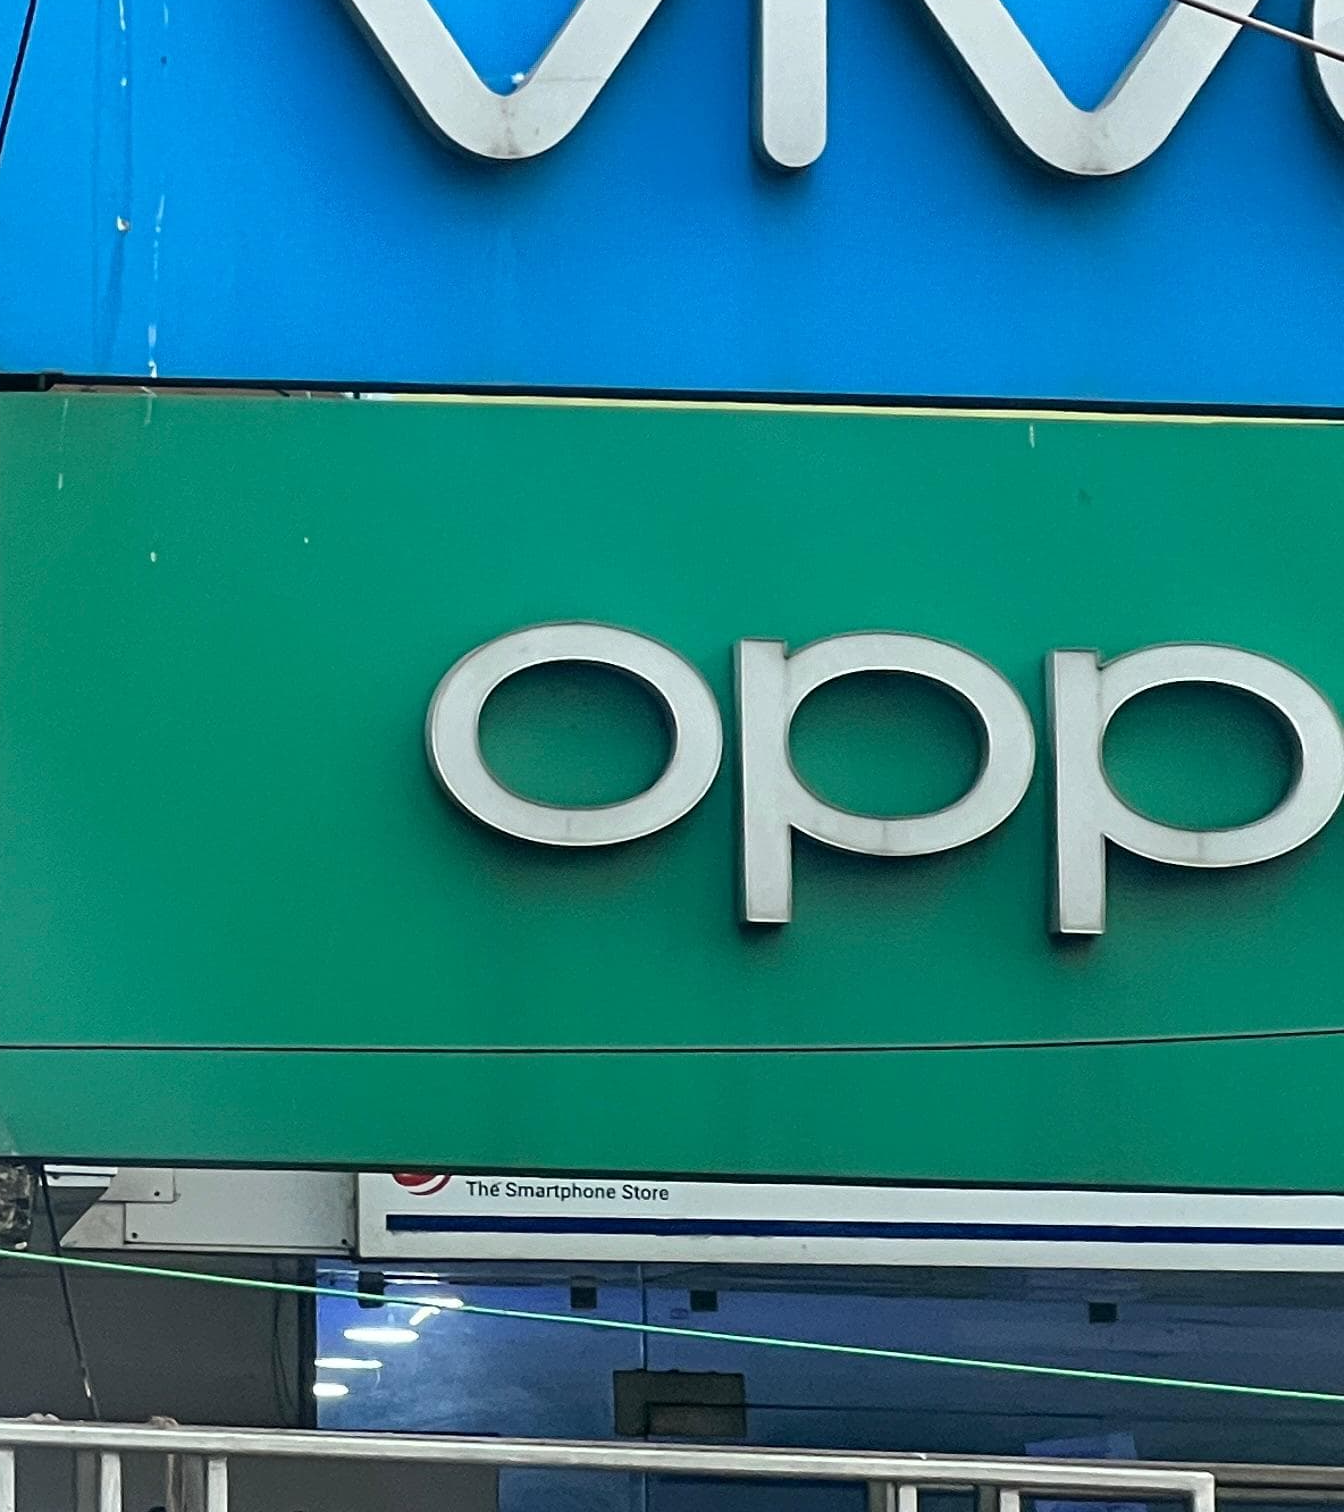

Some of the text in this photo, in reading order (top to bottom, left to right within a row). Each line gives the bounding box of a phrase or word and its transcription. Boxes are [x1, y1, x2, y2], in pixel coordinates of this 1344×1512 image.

[465, 1180, 669, 1201] The Smartphone Store
